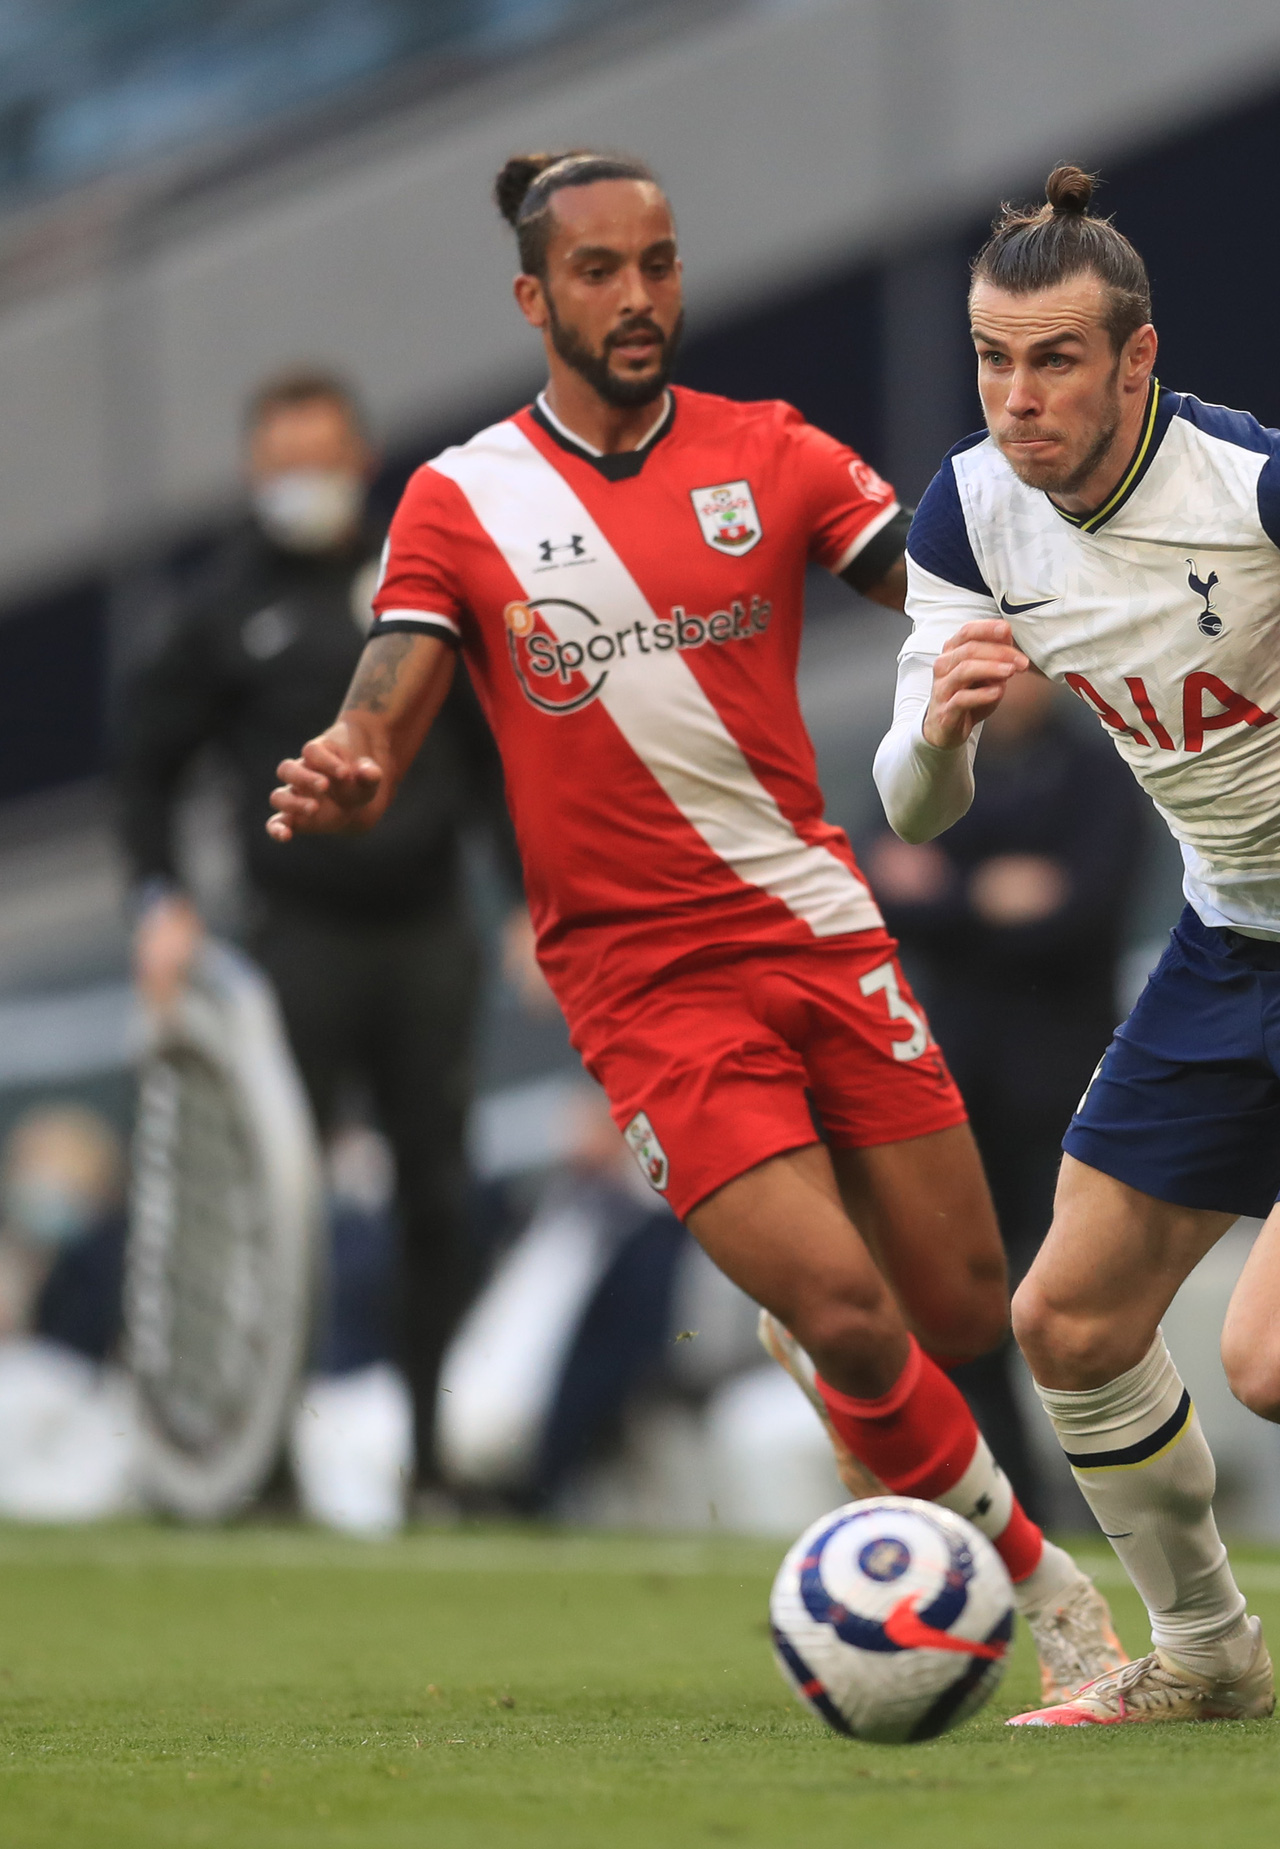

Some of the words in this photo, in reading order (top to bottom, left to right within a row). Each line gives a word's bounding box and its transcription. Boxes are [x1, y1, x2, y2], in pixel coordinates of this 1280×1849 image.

[526, 595, 771, 684] Sportsbet.io
[1064, 671, 1279, 753] AIA
[858, 960, 934, 1062] 3
